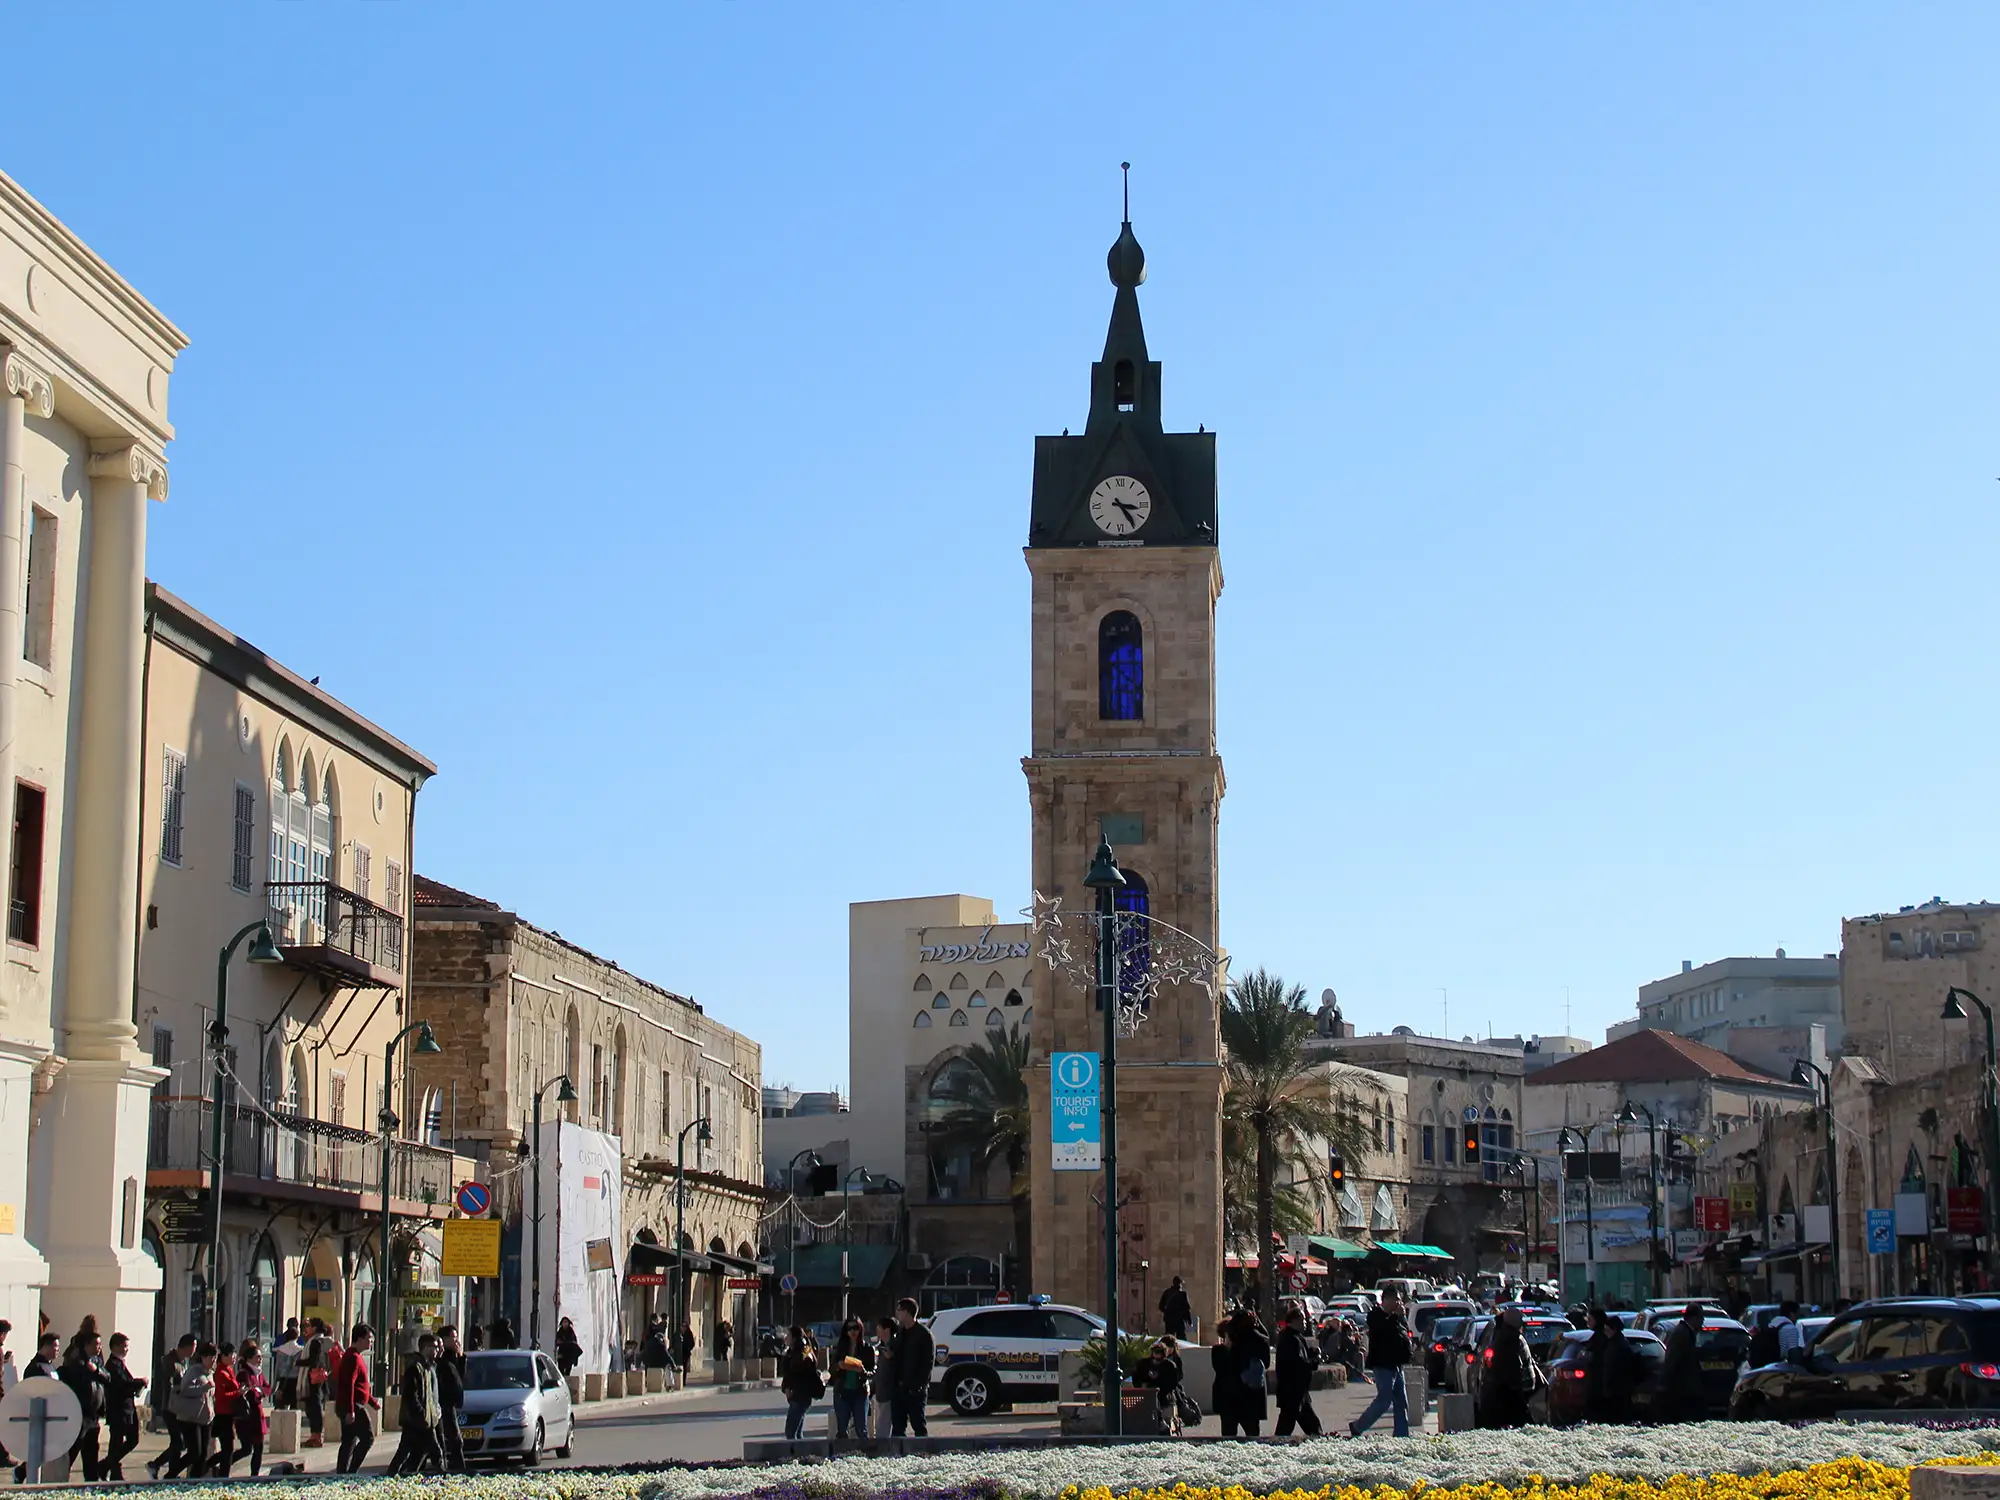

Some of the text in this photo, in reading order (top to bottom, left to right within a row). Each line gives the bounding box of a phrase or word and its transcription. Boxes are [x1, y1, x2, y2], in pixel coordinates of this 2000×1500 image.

[1054, 1096, 1098, 1107] TOURIST
[1064, 1105, 1088, 1117] INFO
[578, 1149, 603, 1168] CASTRO
[629, 1275, 663, 1283] CASTRO
[987, 1351, 1040, 1363] POLICE
